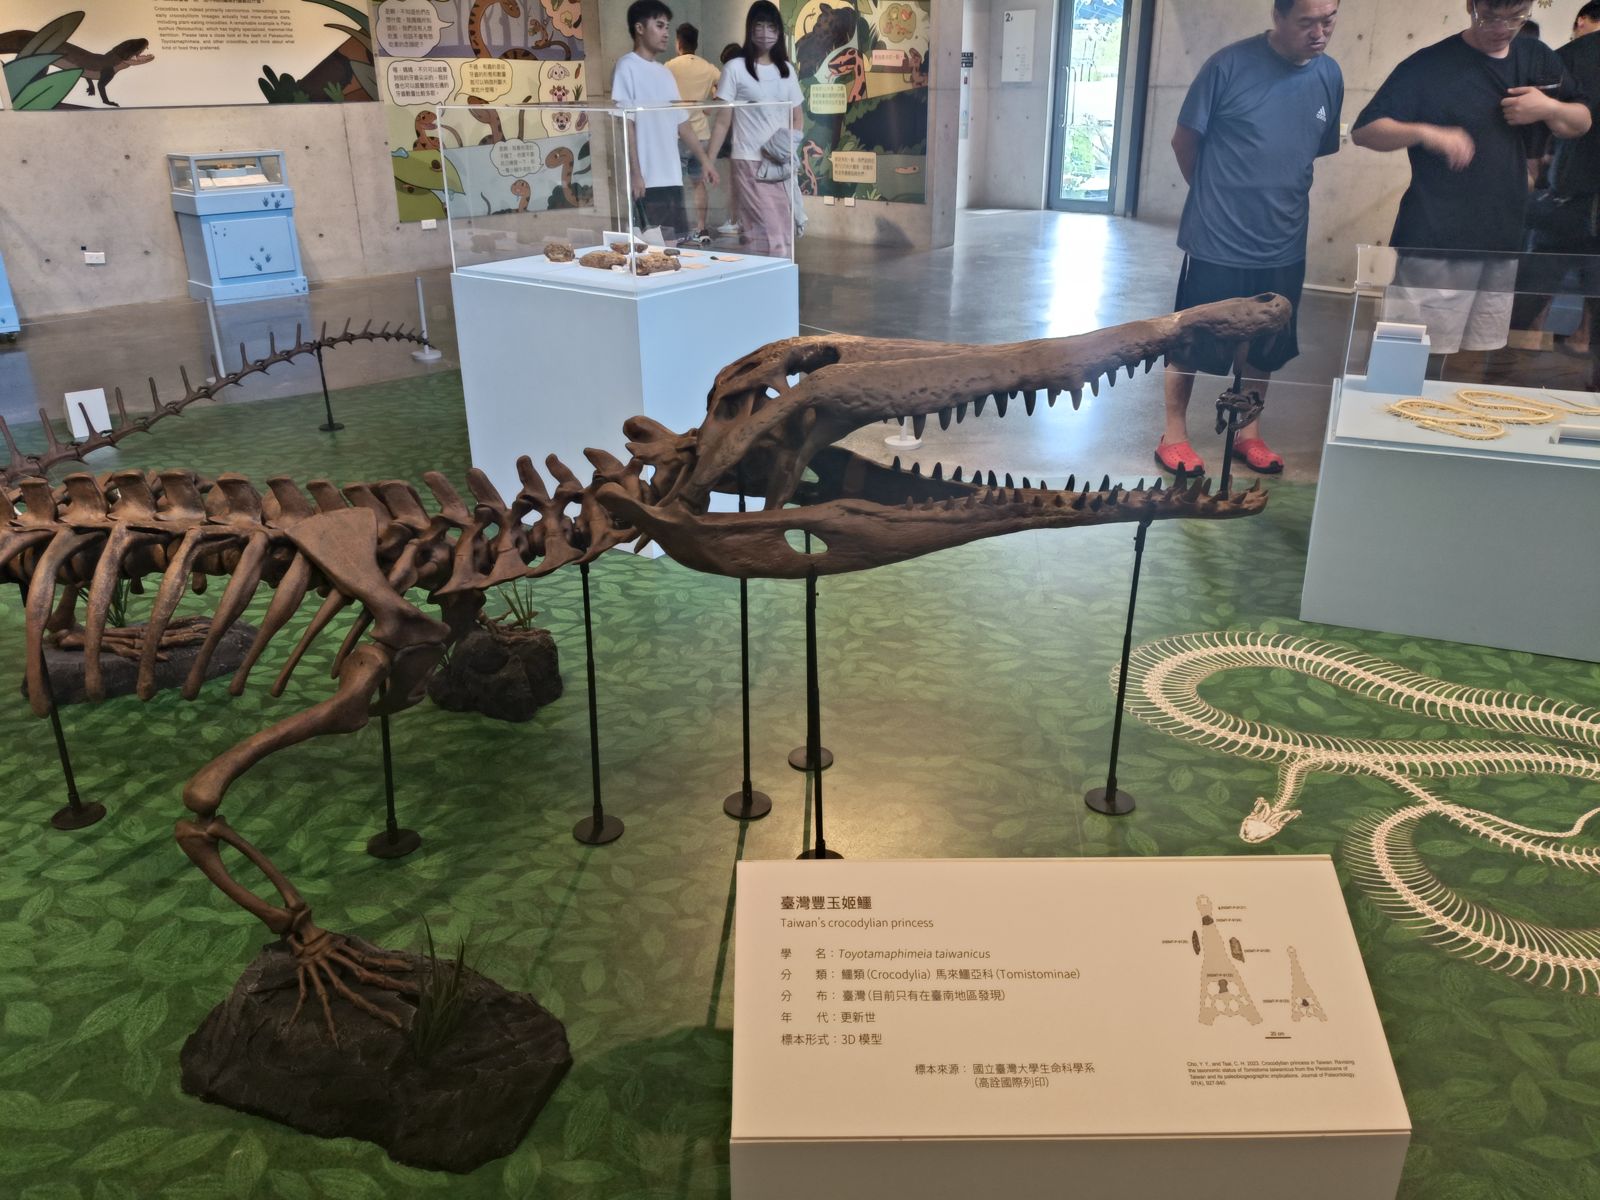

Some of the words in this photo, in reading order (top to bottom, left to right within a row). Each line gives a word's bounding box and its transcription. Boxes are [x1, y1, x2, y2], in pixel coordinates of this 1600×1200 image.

[780, 896, 873, 911] 臺灣豐玉姬鱷
[780, 917, 826, 928] Taiwan's
[828, 918, 888, 930] crocodylian
[891, 918, 934, 930] princess
[935, 949, 991, 960] taiwanicus
